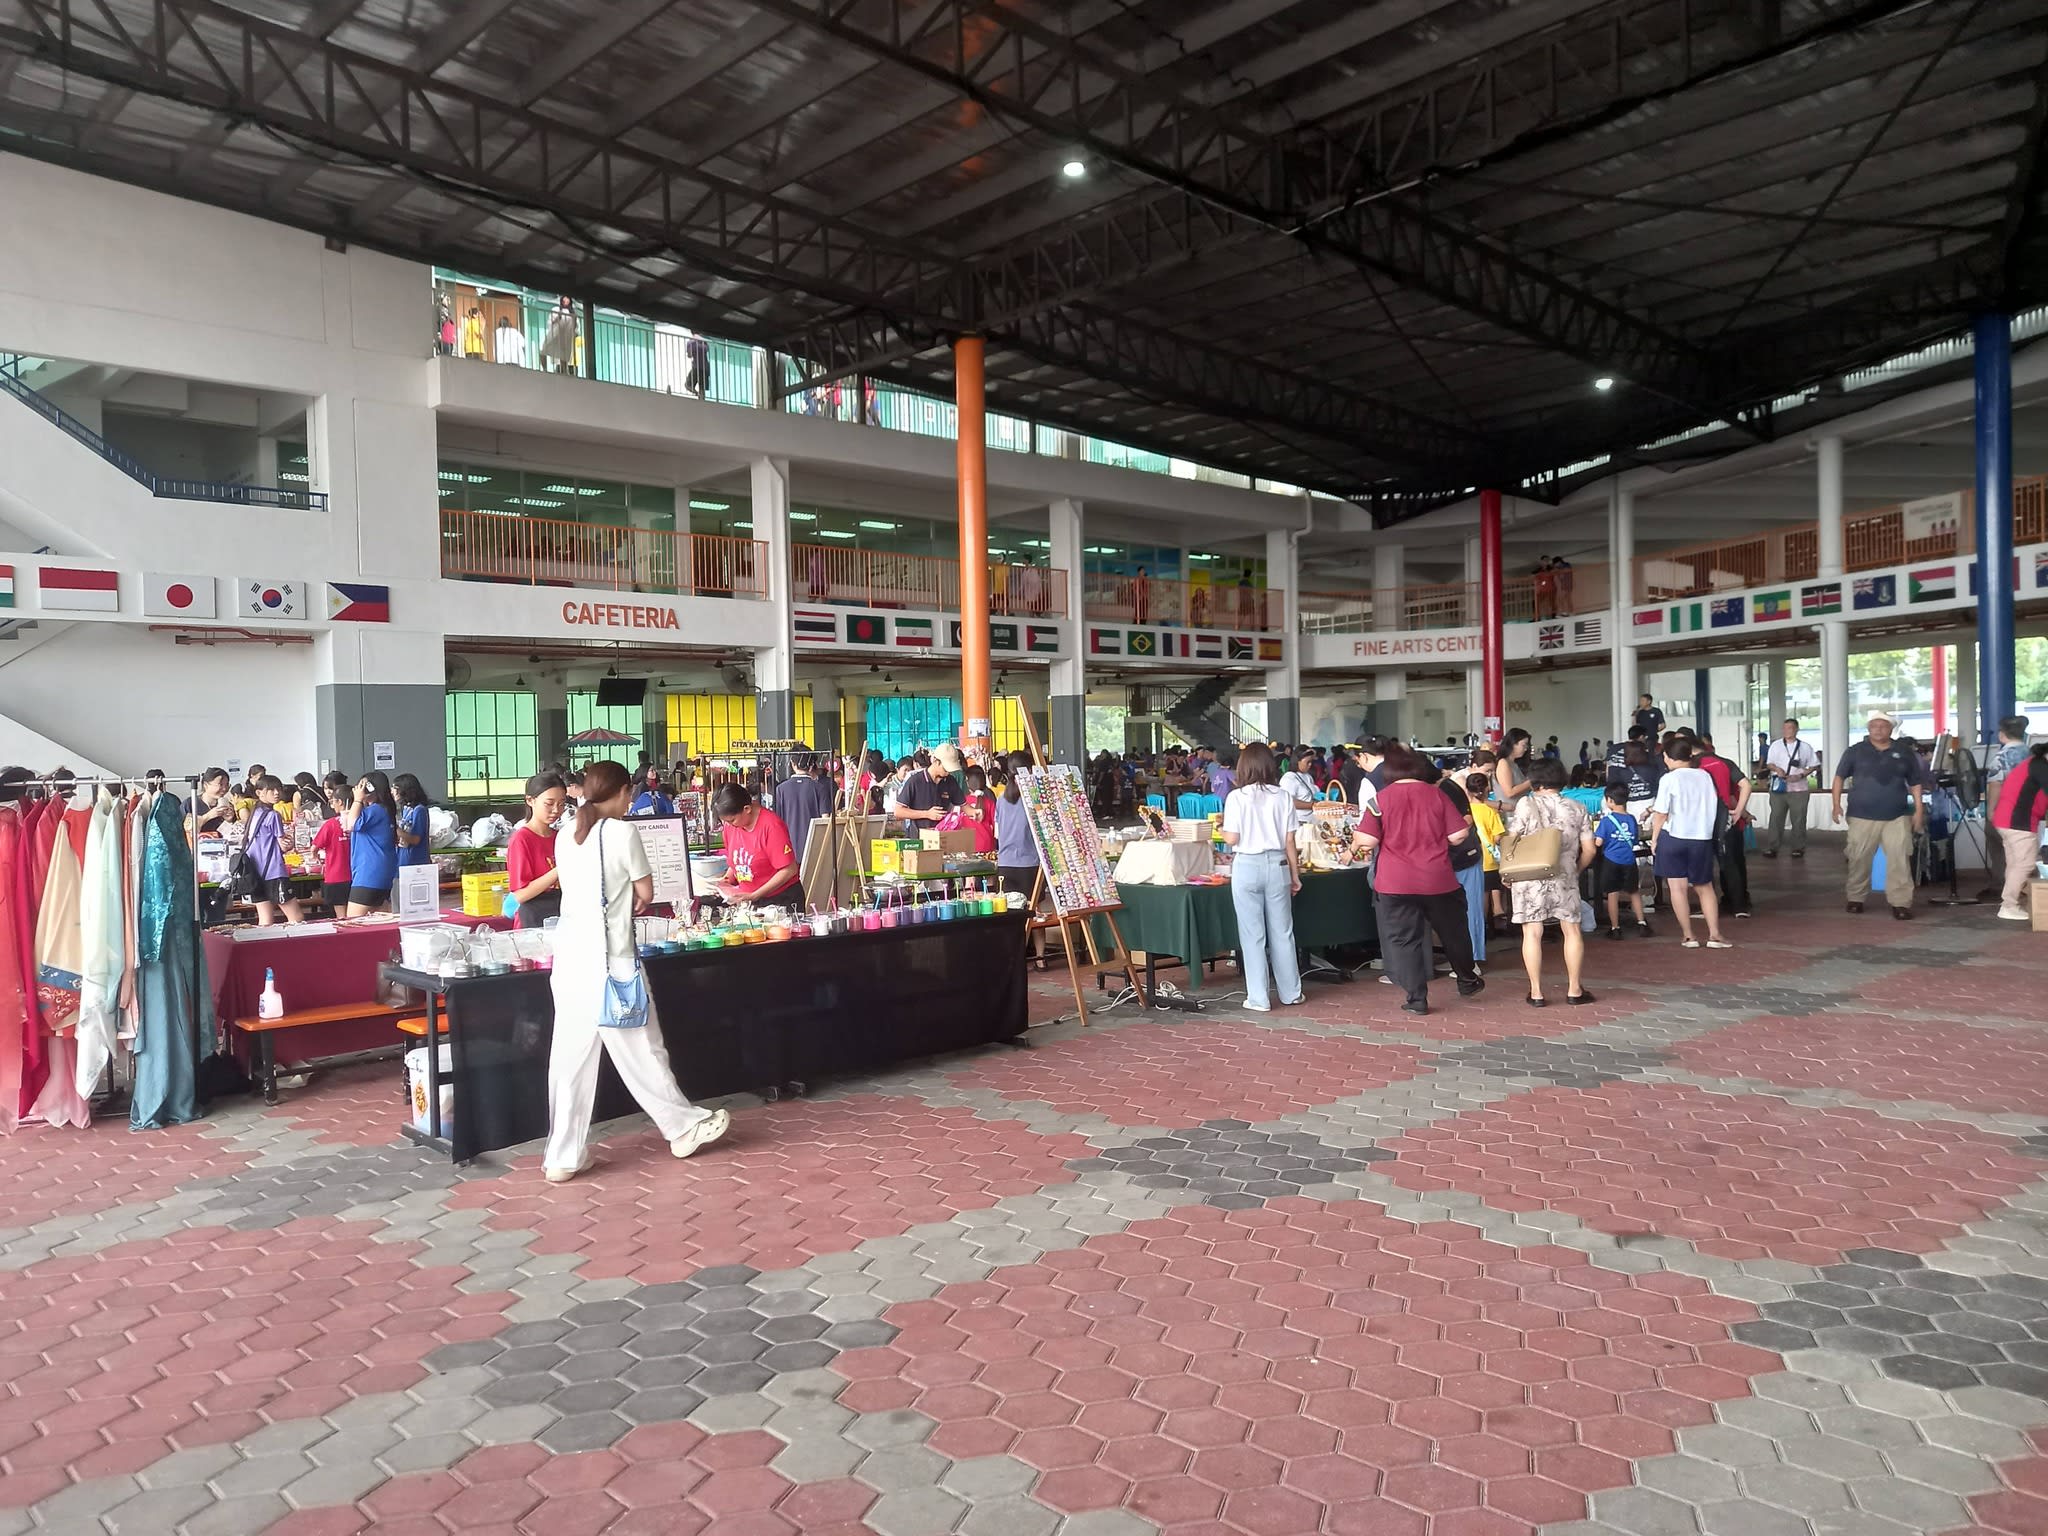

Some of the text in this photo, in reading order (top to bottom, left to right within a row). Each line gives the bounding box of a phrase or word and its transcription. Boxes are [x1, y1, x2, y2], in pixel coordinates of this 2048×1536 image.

[562, 601, 680, 629] CAFETERIA
[1354, 640, 1388, 656] FINE
[1392, 638, 1433, 654] ARTS
[1508, 701, 1532, 712] POOL
